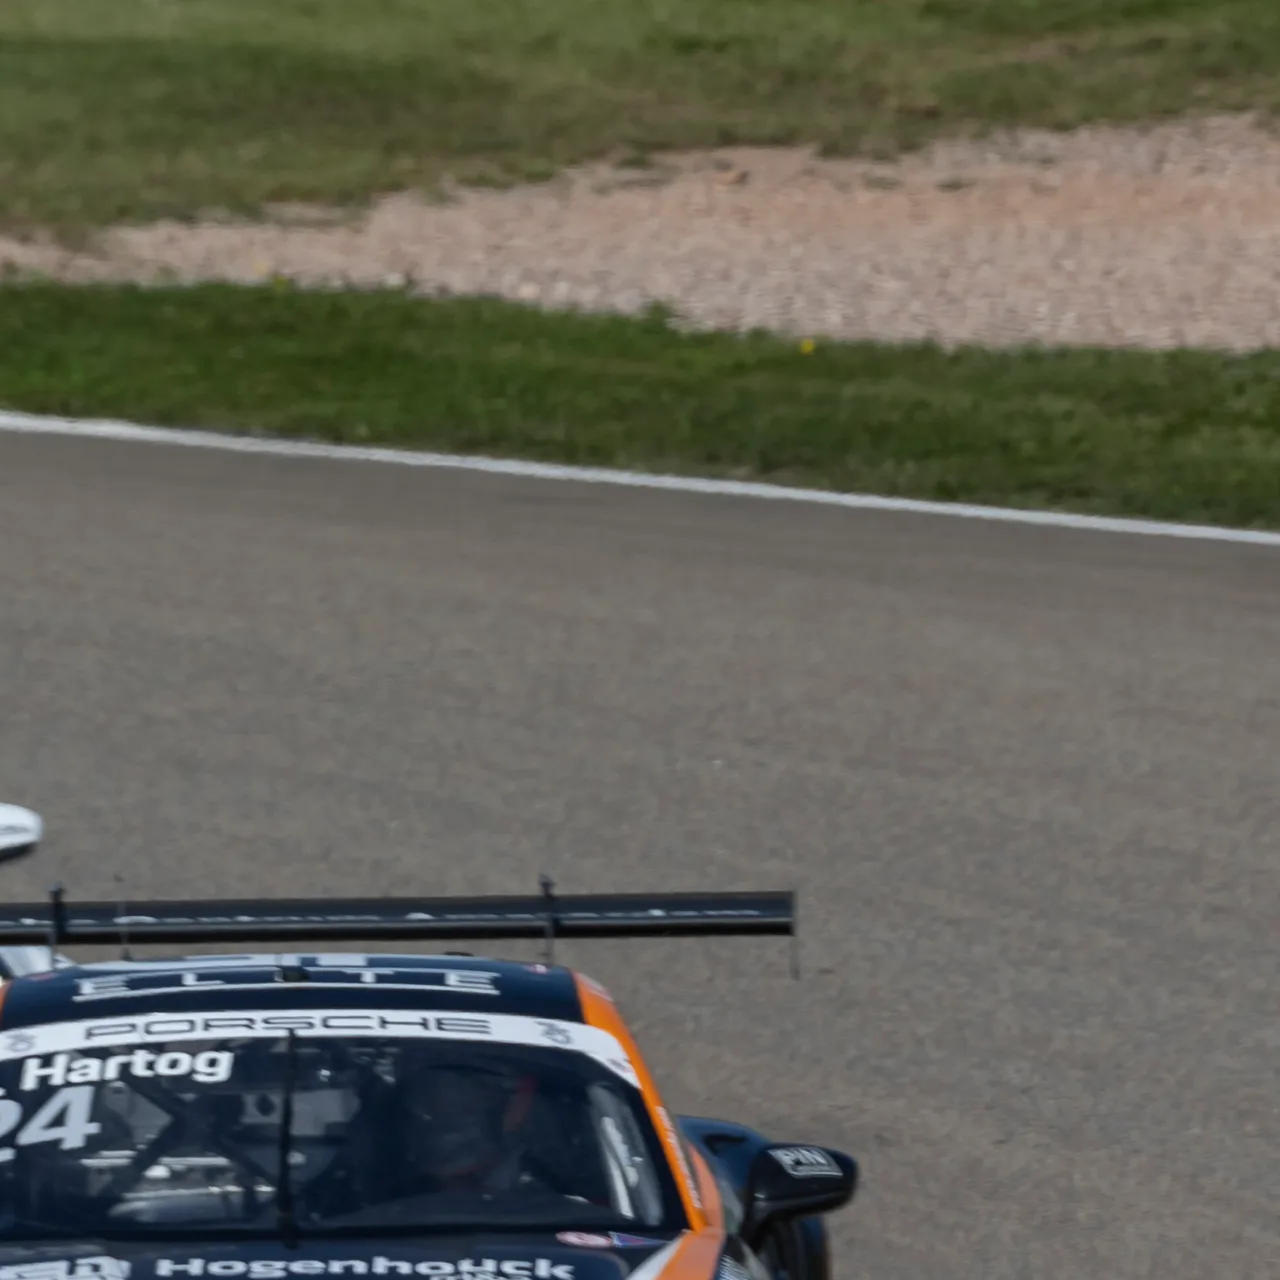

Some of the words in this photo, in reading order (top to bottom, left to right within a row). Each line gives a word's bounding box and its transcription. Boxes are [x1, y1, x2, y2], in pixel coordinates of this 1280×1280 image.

[83, 1014, 494, 1041] PORSCHE
[19, 1050, 236, 1088] Hartog
[154, 1255, 576, 1280] Hogenhouck
